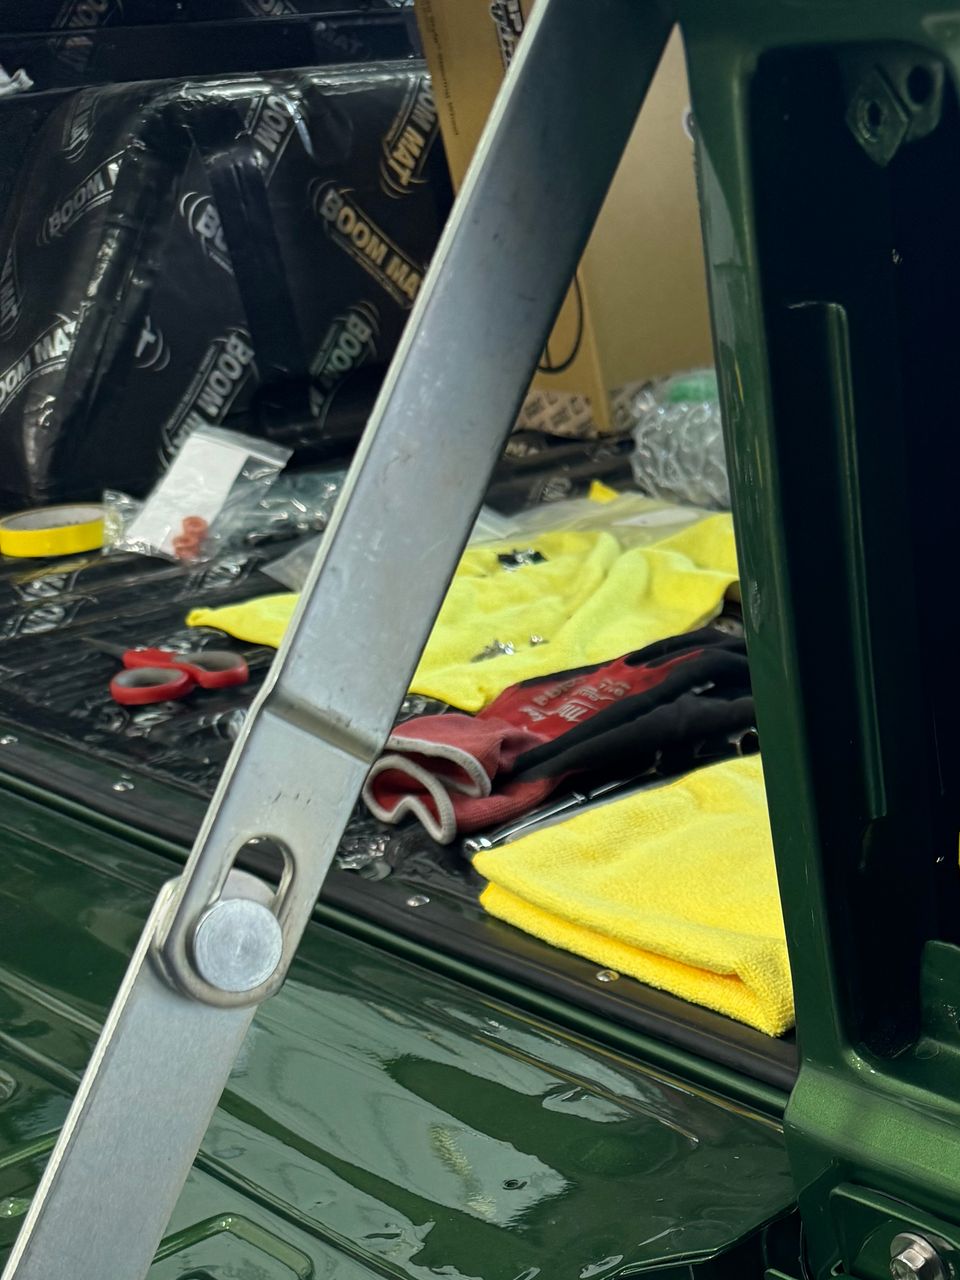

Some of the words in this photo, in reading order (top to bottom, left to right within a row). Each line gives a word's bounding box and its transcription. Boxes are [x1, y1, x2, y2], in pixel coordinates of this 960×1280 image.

[254, 94, 292, 153] OOM
[388, 126, 424, 186] MAT
[48, 171, 106, 236] BOOM
[319, 187, 388, 265] BOOM
[384, 257, 422, 299] MA
[197, 333, 255, 418] BOOM
